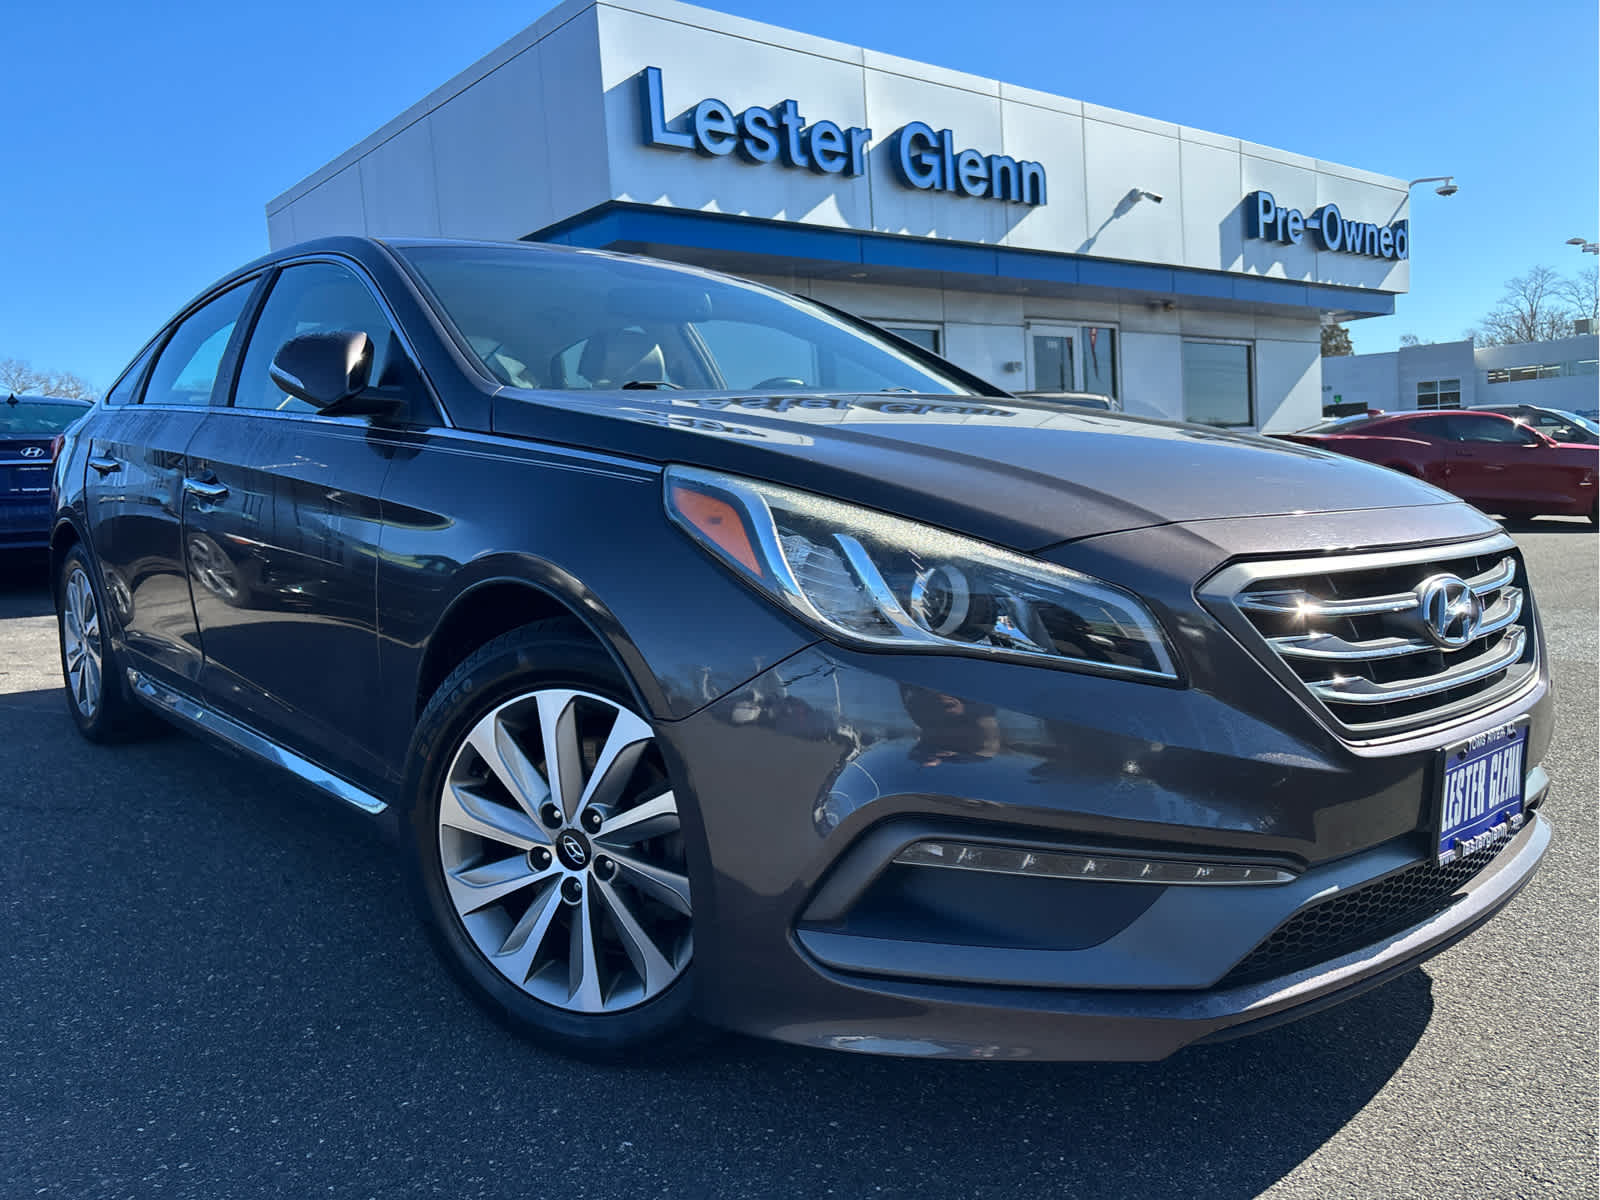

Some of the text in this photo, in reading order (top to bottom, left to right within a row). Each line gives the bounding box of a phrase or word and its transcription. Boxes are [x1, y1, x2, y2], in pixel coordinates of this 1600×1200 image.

[642, 66, 1047, 206] Lester Glenn
[1249, 190, 1408, 261] Pre-Owned
[1441, 742, 1524, 833] LESTER GLENN
